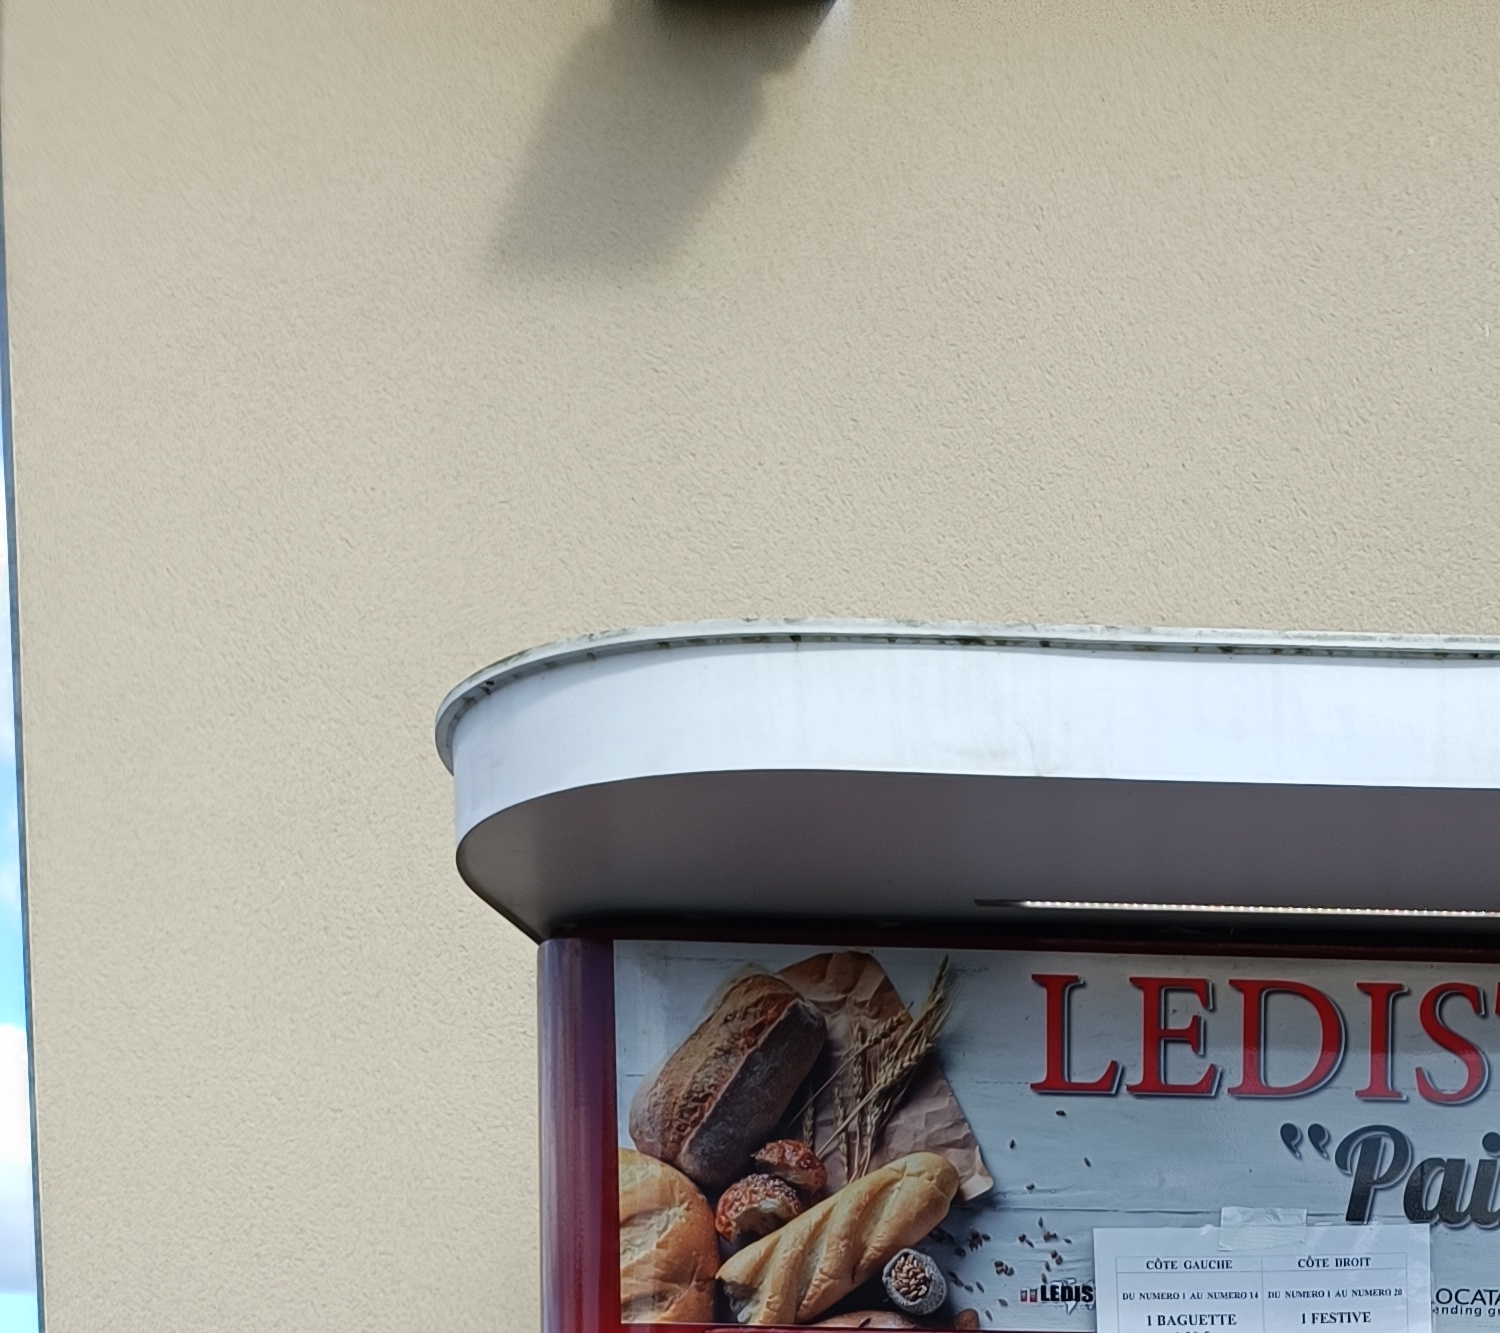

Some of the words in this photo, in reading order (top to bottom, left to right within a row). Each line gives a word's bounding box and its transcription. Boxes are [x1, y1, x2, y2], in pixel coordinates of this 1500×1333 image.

[1146, 1257, 1178, 1270] CÔTE
[1184, 1260, 1233, 1270] GAUCHE
[1298, 1255, 1329, 1268] CÔTE
[1335, 1257, 1371, 1267] DROIT
[1122, 1292, 1135, 1300] DU
[1139, 1292, 1180, 1300] NUMERO
[1190, 1292, 1203, 1300] AU
[1207, 1292, 1247, 1300] NUMERO
[1268, 1290, 1280, 1299] DU
[1285, 1290, 1324, 1298] NUMERO
[1335, 1289, 1348, 1298] AU
[1352, 1289, 1391, 1297] NUMERO
[1147, 1315, 1152, 1326] 1
[1157, 1314, 1237, 1326] BAGUETTE
[1302, 1313, 1306, 1324] 1
[1311, 1312, 1371, 1324] FESTIVE
